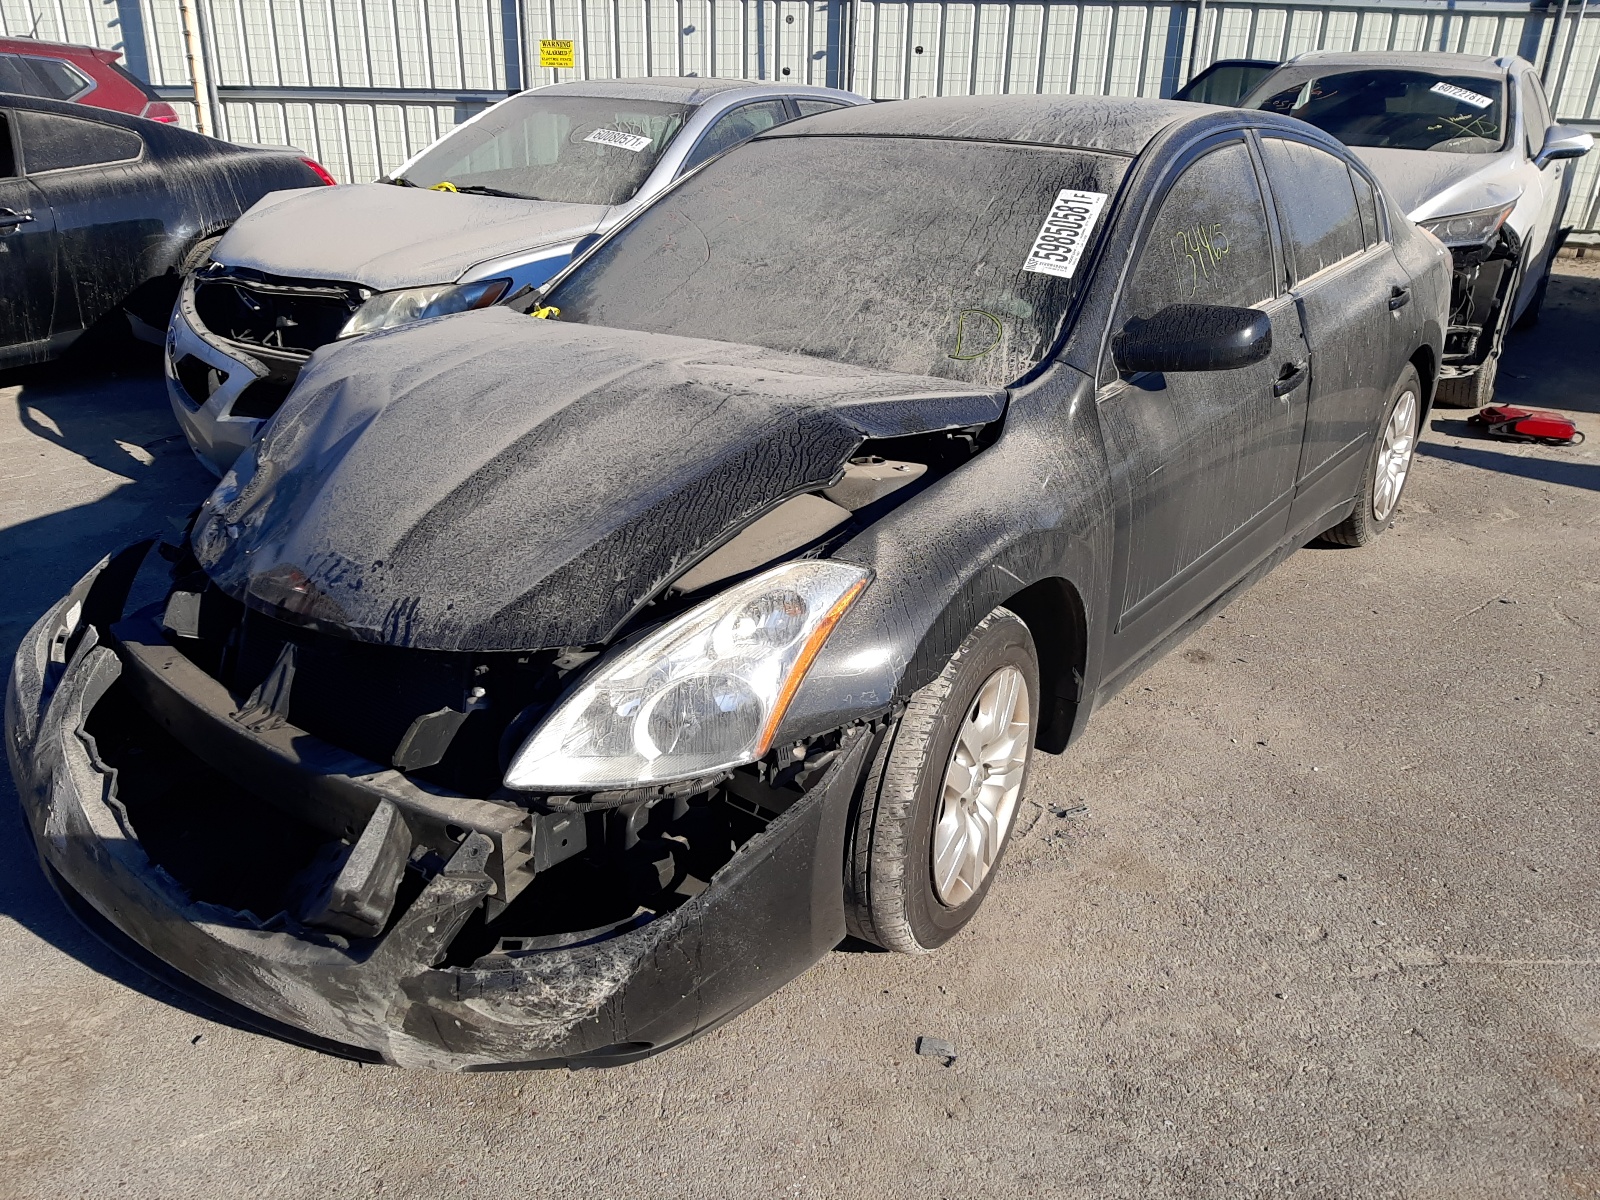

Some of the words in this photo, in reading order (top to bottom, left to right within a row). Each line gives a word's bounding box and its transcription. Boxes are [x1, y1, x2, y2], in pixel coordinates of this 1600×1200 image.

[541, 40, 571, 48] WARNING
[1437, 83, 1482, 104] 60722781
[592, 129, 642, 147] 60080571
[1032, 198, 1093, 263] 59850581
[948, 309, 1003, 360] D
